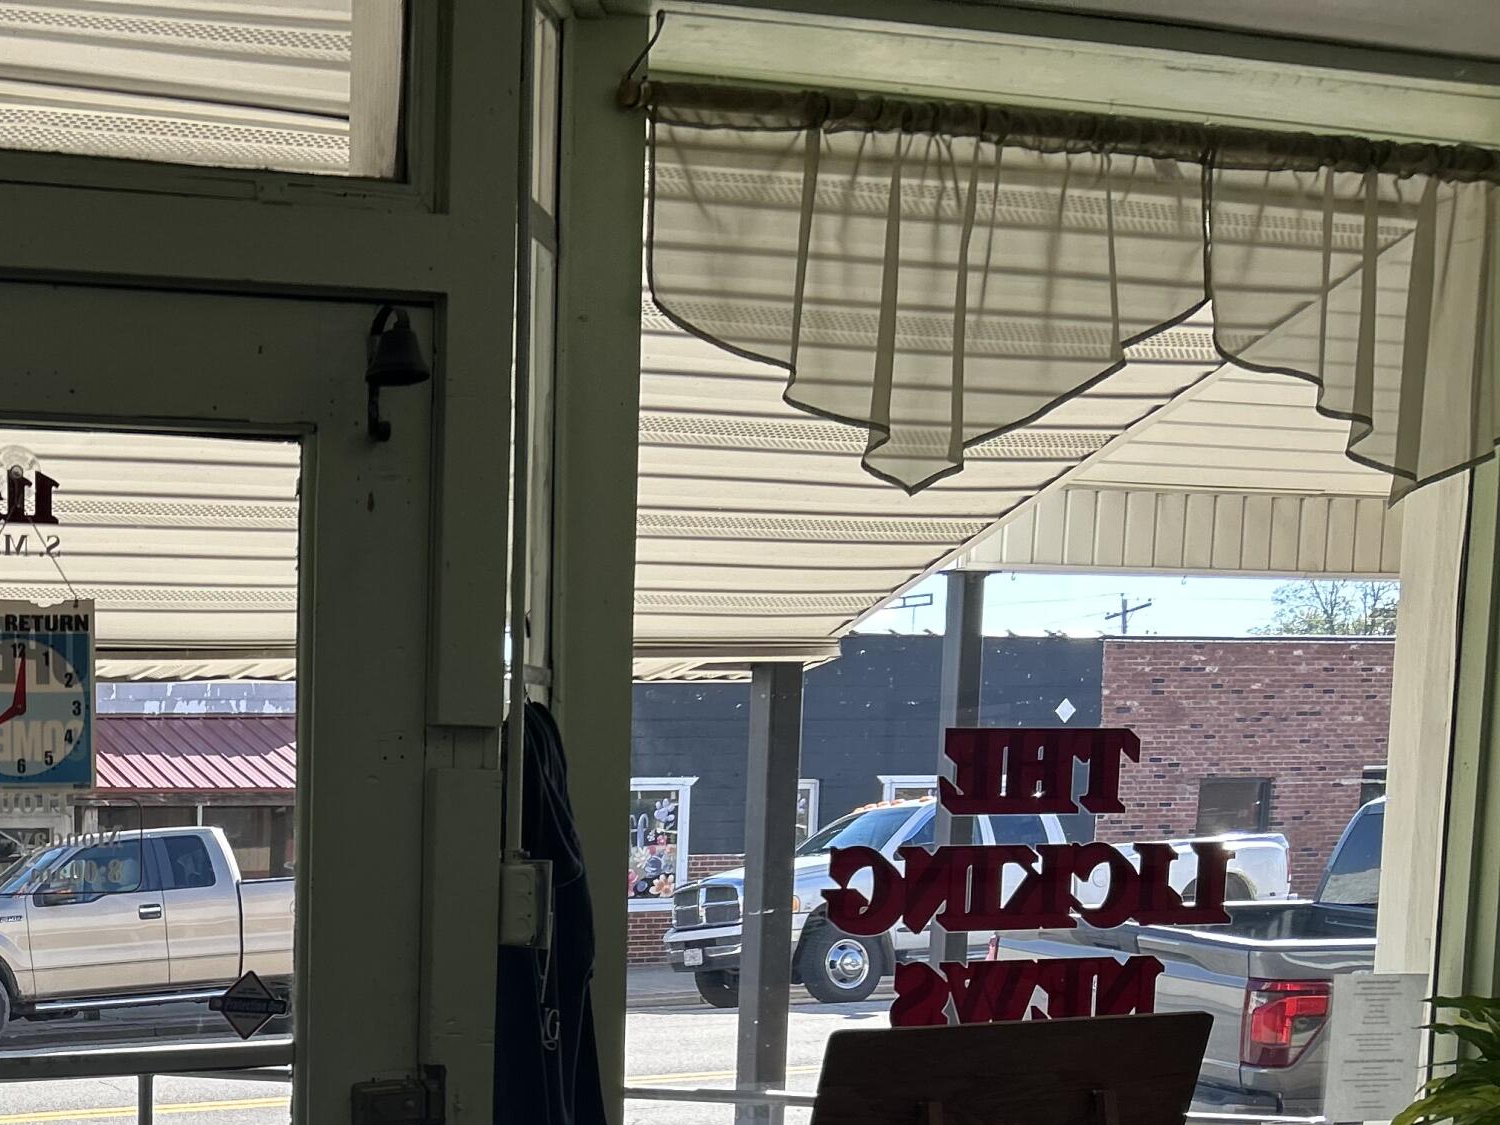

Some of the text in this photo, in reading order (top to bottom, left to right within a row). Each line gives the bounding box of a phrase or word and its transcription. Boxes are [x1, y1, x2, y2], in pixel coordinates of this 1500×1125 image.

[5, 614, 89, 632] RETURN
[11, 643, 26, 659] 12
[42, 651, 50, 666] 1
[64, 672, 74, 688] 2
[72, 700, 82, 716] 3
[64, 729, 73, 744] 4
[44, 750, 53, 765] 5
[17, 758, 26, 774] 6
